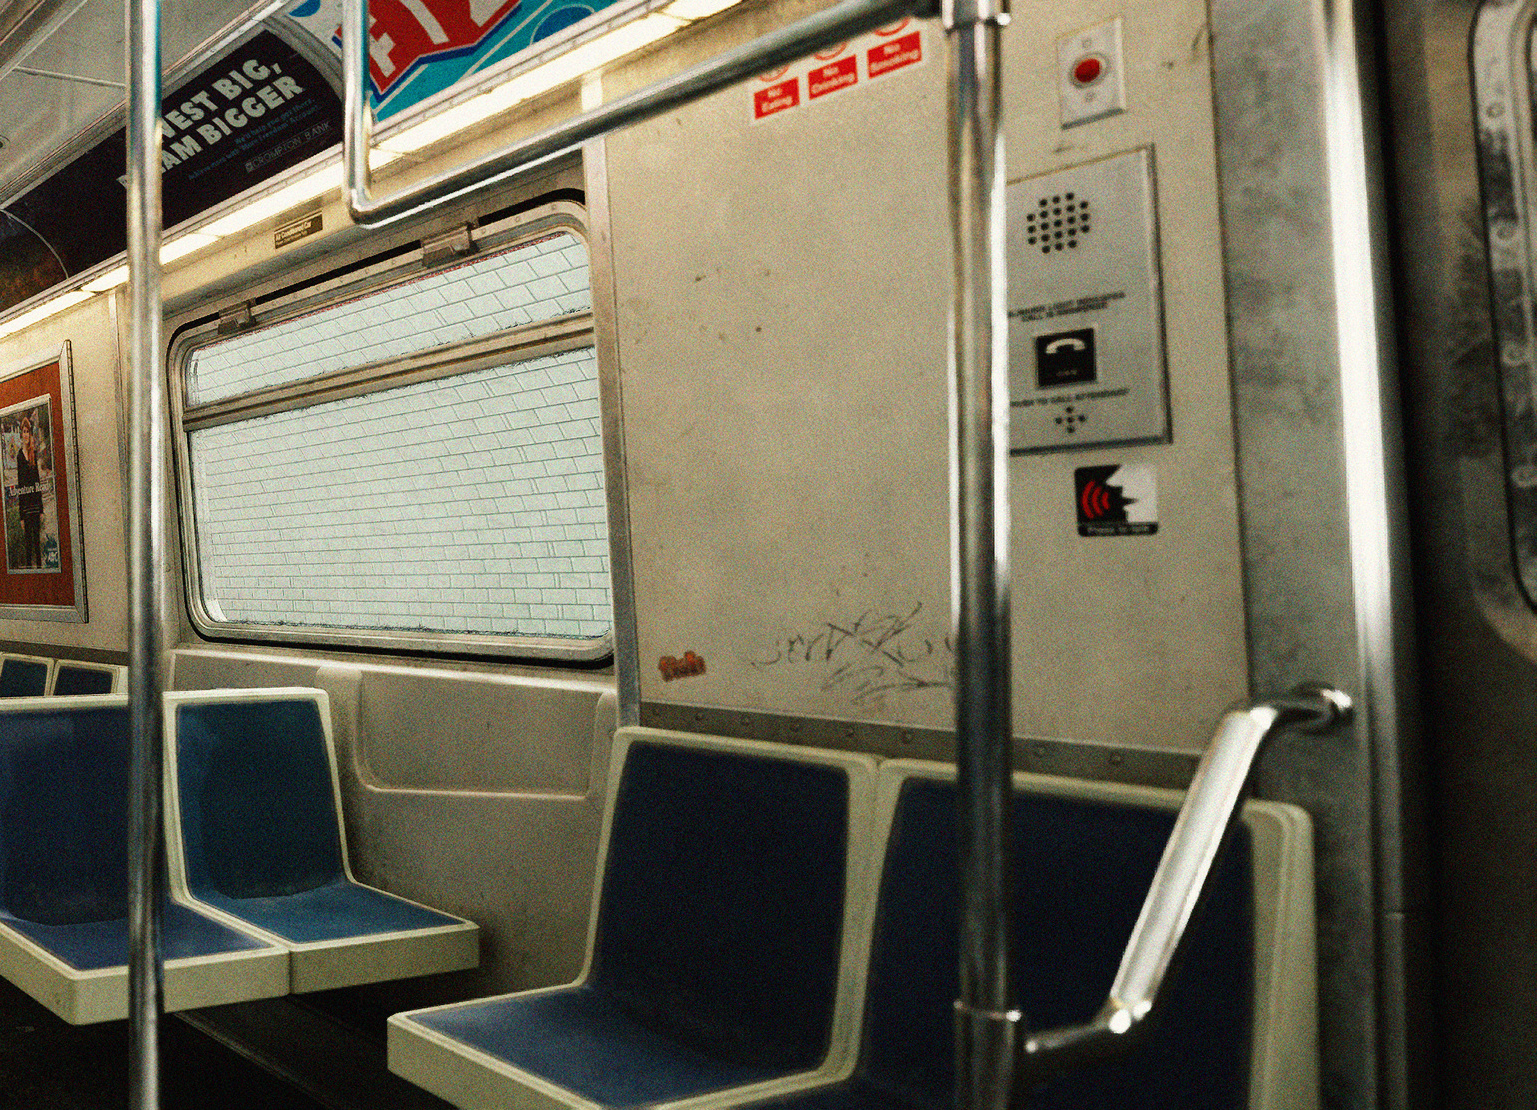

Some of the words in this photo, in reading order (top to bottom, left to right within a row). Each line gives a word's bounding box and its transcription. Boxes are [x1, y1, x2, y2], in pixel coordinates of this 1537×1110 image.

[162, 90, 218, 138] VEST
[211, 59, 282, 100] BIG,
[196, 75, 304, 145] BIGGER
[252, 137, 302, 168] CROMPTON
[304, 121, 330, 140] BANK
